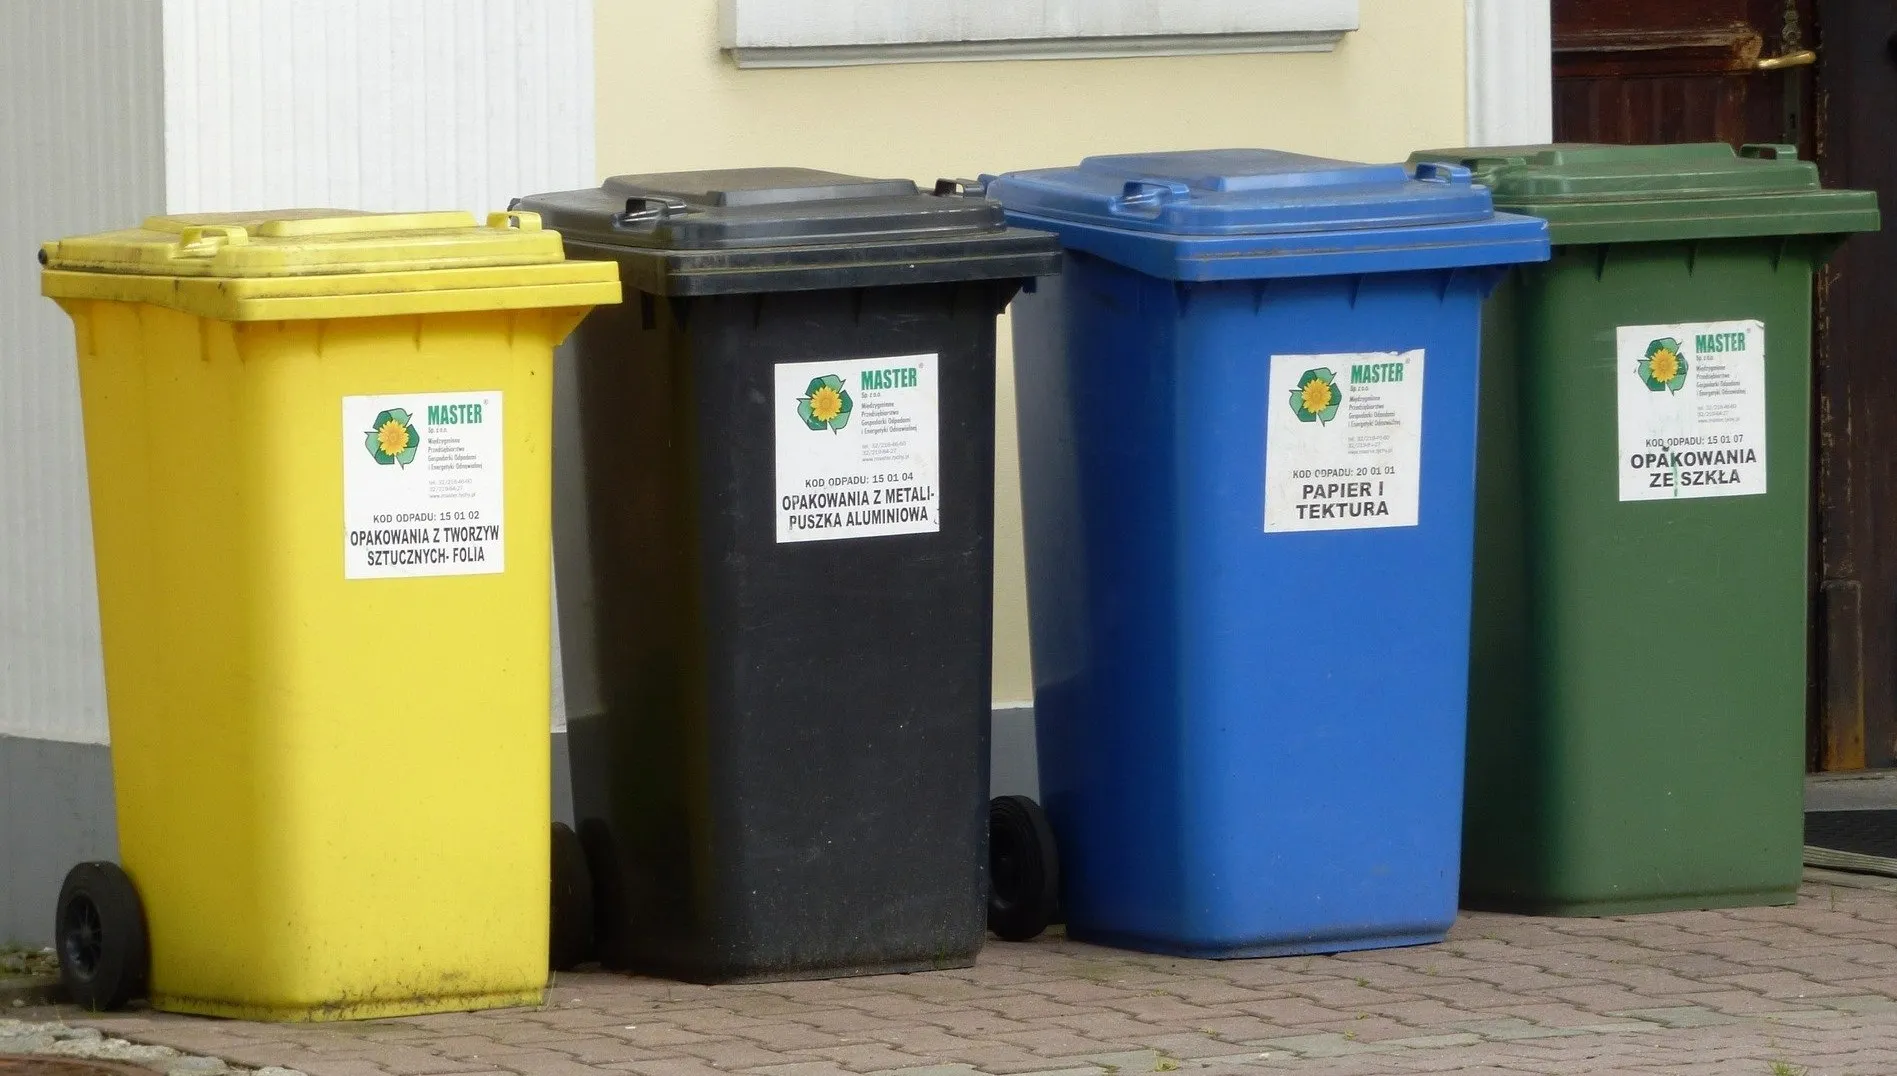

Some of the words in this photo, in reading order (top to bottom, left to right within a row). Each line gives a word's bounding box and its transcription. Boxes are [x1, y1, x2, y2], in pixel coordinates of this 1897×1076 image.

[1696, 332, 1745, 353] MASTER
[862, 368, 917, 390] MASTER
[1351, 363, 1403, 384] MASTER
[428, 404, 482, 425] MASTER
[1645, 439, 1664, 447] KOD
[1667, 437, 1705, 446] ODPADU:
[1708, 436, 1718, 444] 15
[1720, 435, 1730, 443] 01
[1733, 434, 1743, 443] 07
[1630, 448, 1756, 469] OPAKOWANIA
[805, 478, 825, 488] KOD
[828, 476, 869, 486] ODPADU:
[872, 475, 884, 483] 15
[887, 474, 898, 482] 01
[902, 472, 914, 481] 04
[1293, 470, 1311, 479] KOD
[1315, 468, 1354, 478] ODPADU:
[1356, 467, 1367, 476] 20
[1370, 467, 1381, 475] 01
[1384, 466, 1395, 474] 01
[1650, 472, 1674, 488] ZE
[1680, 469, 1740, 486] SZKŁA
[782, 490, 869, 510] OPAKOWANIA
[873, 490, 881, 504] Z
[886, 486, 934, 504] METALI-
[1303, 482, 1371, 499] PAPIER
[1379, 481, 1384, 496] I
[374, 514, 392, 523] KOD
[396, 512, 436, 522] ODPADU:
[440, 512, 451, 520] 15
[454, 512, 465, 520] 01
[468, 511, 480, 519] 02
[789, 512, 842, 530] PUSZKA
[846, 506, 928, 526] ALUMINIOWA
[1296, 501, 1389, 519] TEKTURA
[350, 528, 430, 546] OPAKOWANIA
[433, 528, 440, 542] Z
[444, 525, 499, 542] TWORZYW
[367, 548, 449, 566] SZTUCZNYCH-
[453, 546, 485, 562] FOLIA
